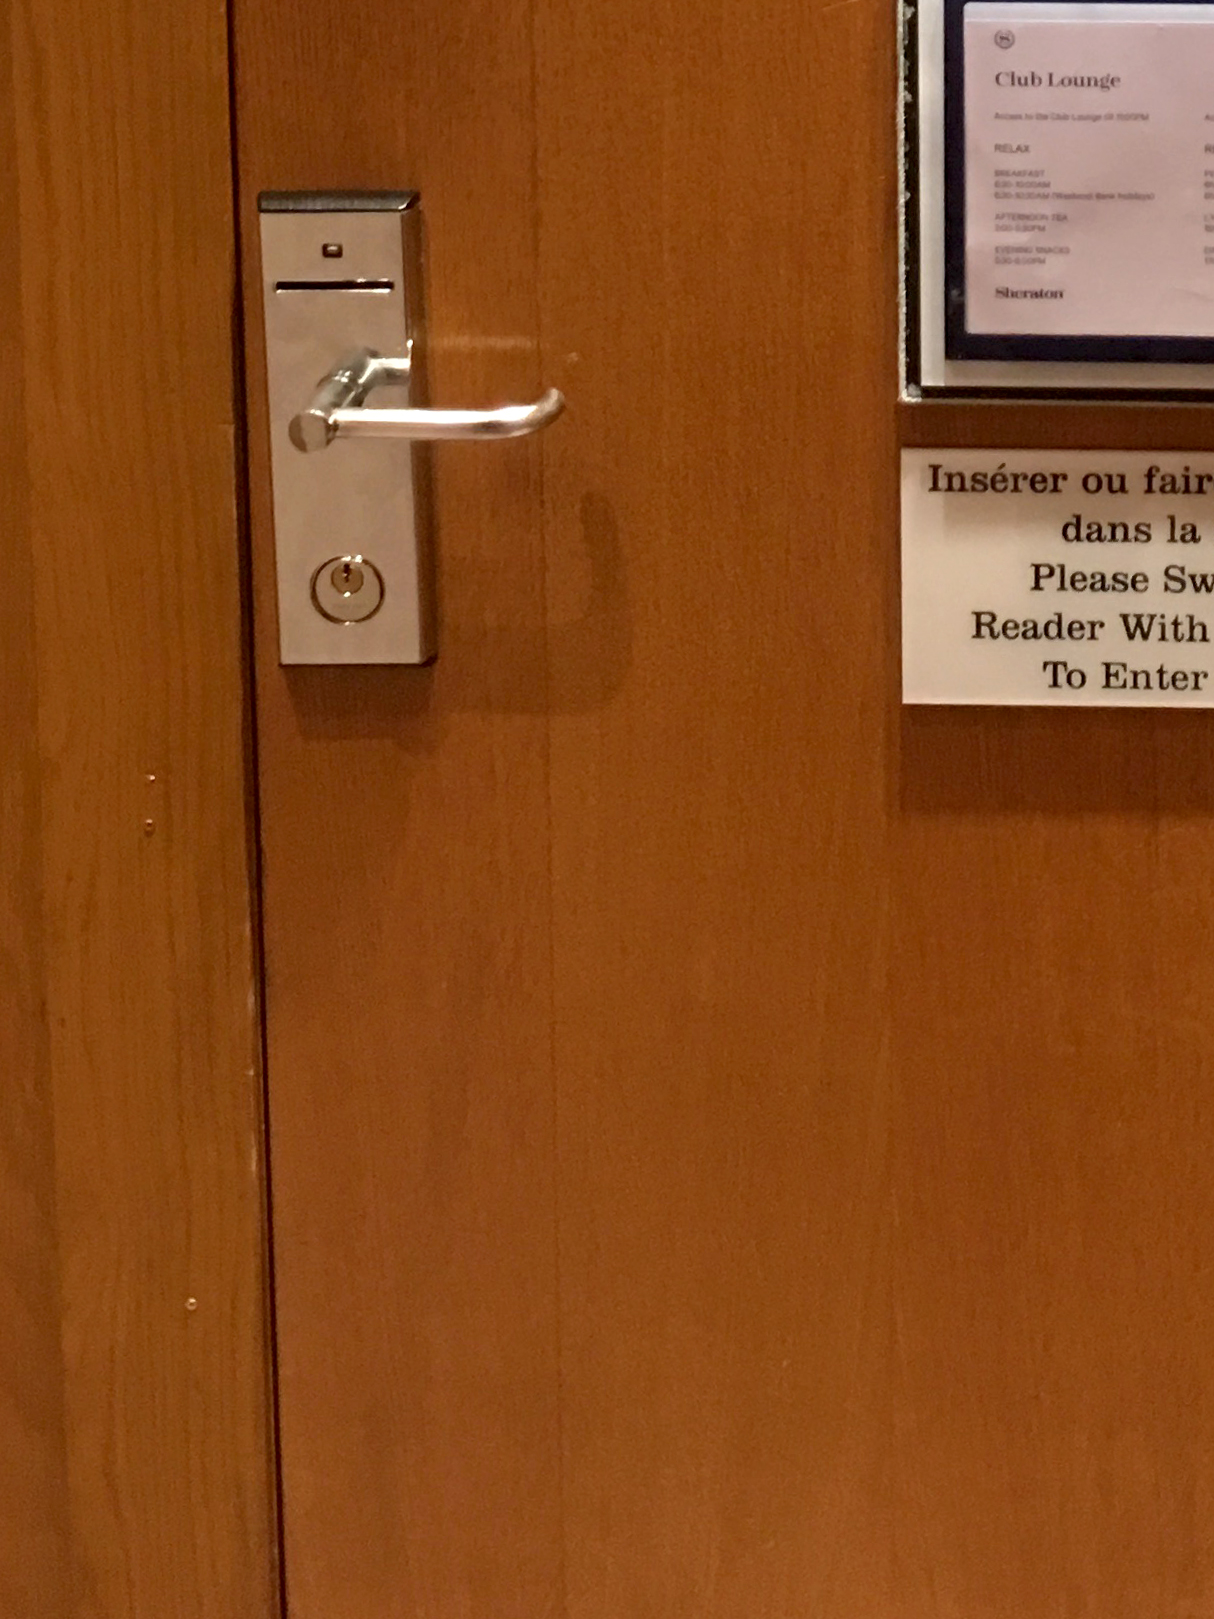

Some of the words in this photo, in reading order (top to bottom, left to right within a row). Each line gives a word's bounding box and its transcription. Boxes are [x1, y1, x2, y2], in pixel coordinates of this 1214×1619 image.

[994, 70, 1043, 88] Club
[1047, 71, 1122, 92] Lounge
[994, 143, 1030, 154] RELAX
[994, 169, 1045, 178] BREAKFAST
[994, 286, 1065, 300] Sheraton
[927, 463, 1069, 496] Insérer
[1081, 472, 1130, 496] ou
[1061, 513, 1153, 545] dans
[1166, 514, 1202, 545] la
[1029, 563, 1150, 595] Please
[970, 610, 1106, 642] Reader
[1118, 612, 1211, 644] With
[1042, 660, 1087, 691] To
[1101, 661, 1209, 693] Enter
